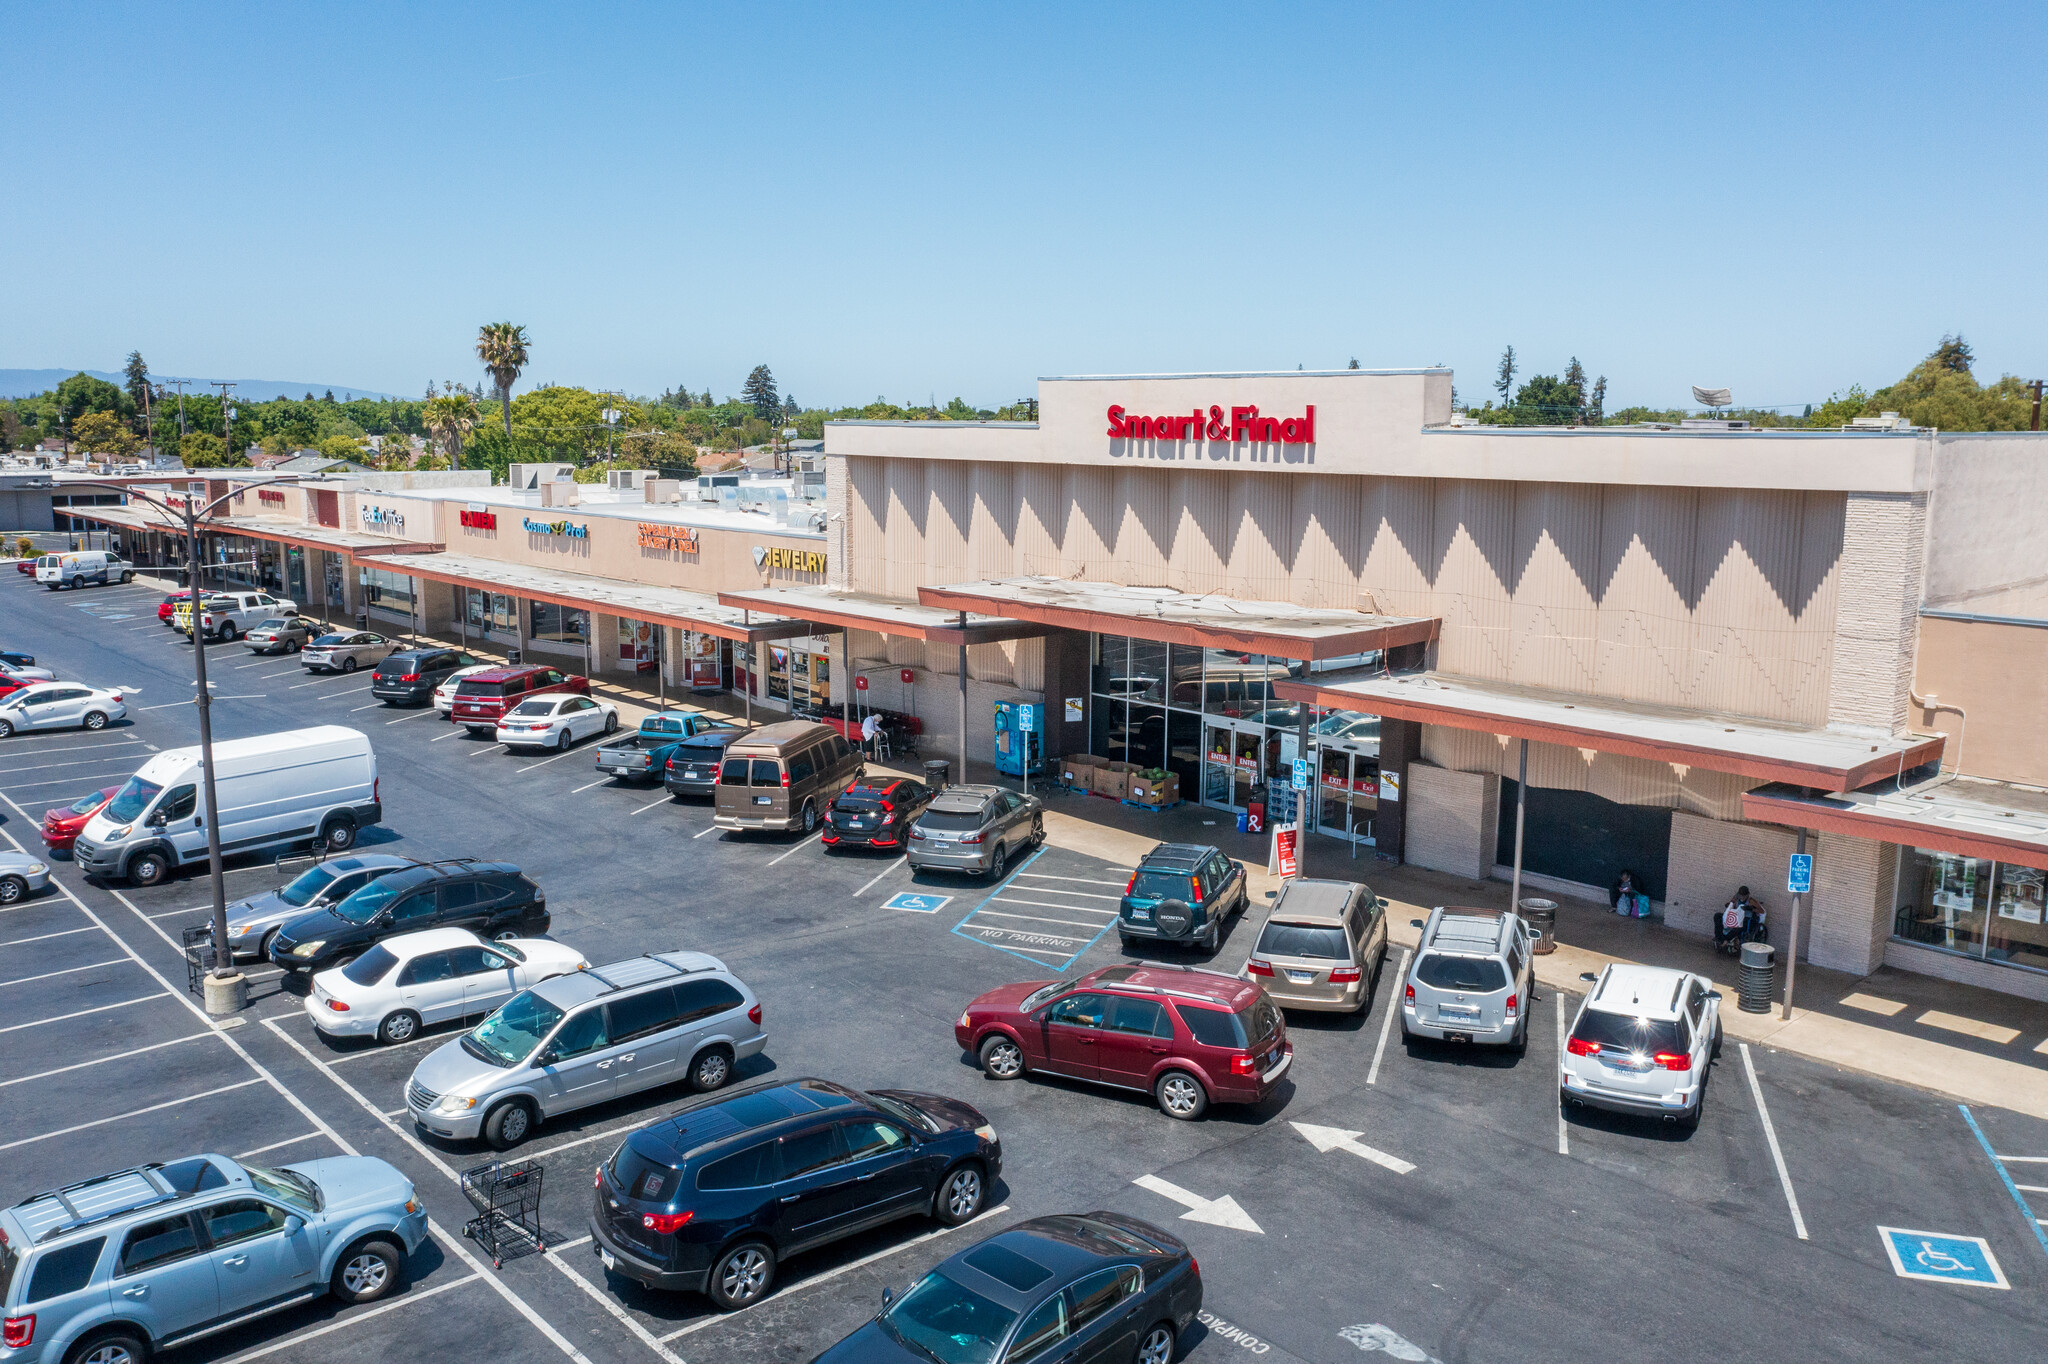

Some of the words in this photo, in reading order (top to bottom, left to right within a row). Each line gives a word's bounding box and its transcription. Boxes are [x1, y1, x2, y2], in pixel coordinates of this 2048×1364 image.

[1107, 404, 1317, 444] Smart&Final
[361, 504, 383, 523] FedEx
[382, 508, 403, 526] Office
[460, 510, 496, 530] RAMEN
[522, 517, 551, 535] Cosmo
[565, 523, 587, 539] Prof
[637, 522, 690, 539] COPENHAGEN
[637, 535, 669, 550] BAKERY
[670, 538, 678, 551] &
[678, 539, 697, 553] DELI
[765, 547, 827, 573] JEWELRY
[1211, 752, 1228, 762] ENTER
[1239, 758, 1257, 767] ENTER
[1328, 776, 1342, 785] EXIT
[1362, 784, 1374, 792] Exit
[980, 929, 1004, 938] NO
[1008, 933, 1074, 947] PARKING
[1196, 1309, 1270, 1354] COMPAC
